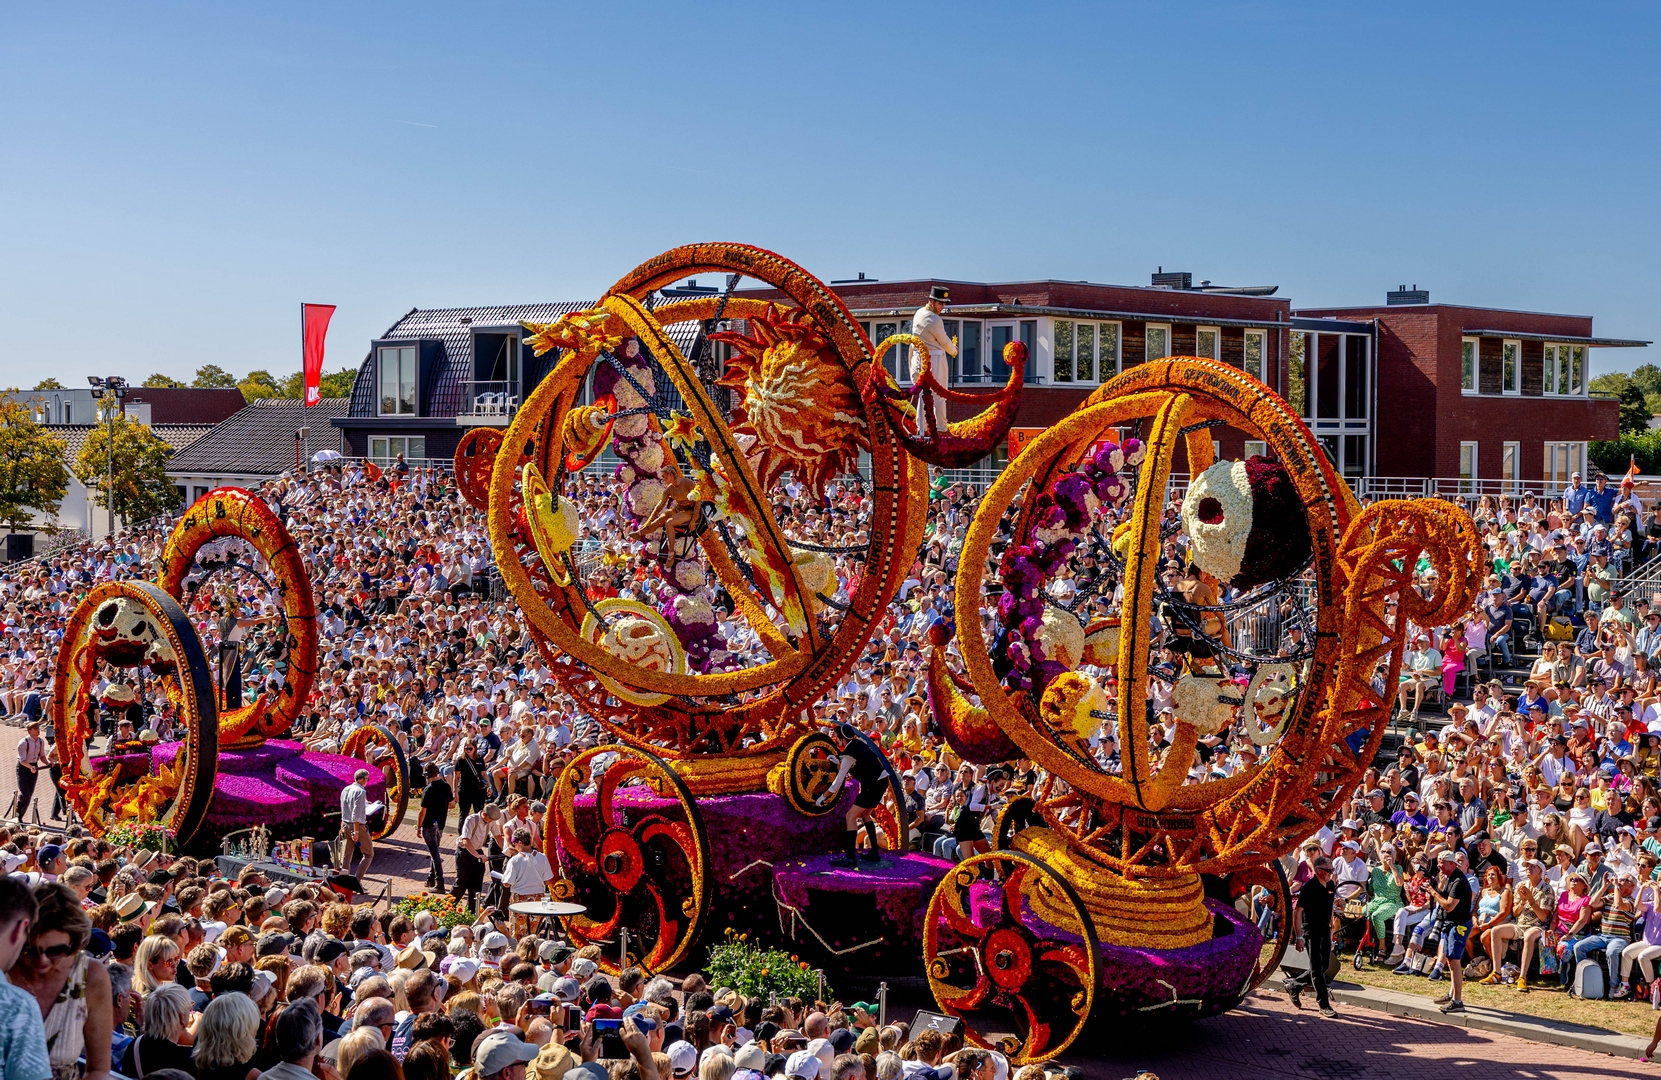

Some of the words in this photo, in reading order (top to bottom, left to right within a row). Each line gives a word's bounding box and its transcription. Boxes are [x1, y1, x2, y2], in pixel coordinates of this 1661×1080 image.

[812, 302, 837, 328] ARIES
[1102, 367, 1149, 398] AUGUSTUS
[1184, 367, 1241, 399] SEPTEMBER
[870, 400, 887, 445] TAURUS
[1018, 431, 1024, 442] B
[1270, 421, 1306, 474] OCTOBER
[868, 531, 884, 576] GEMINI
[1316, 528, 1333, 606] NOVEMBER
[809, 646, 841, 681] CANCER
[1295, 662, 1326, 736] DECEMBER
[239, 933, 249, 943] 38
